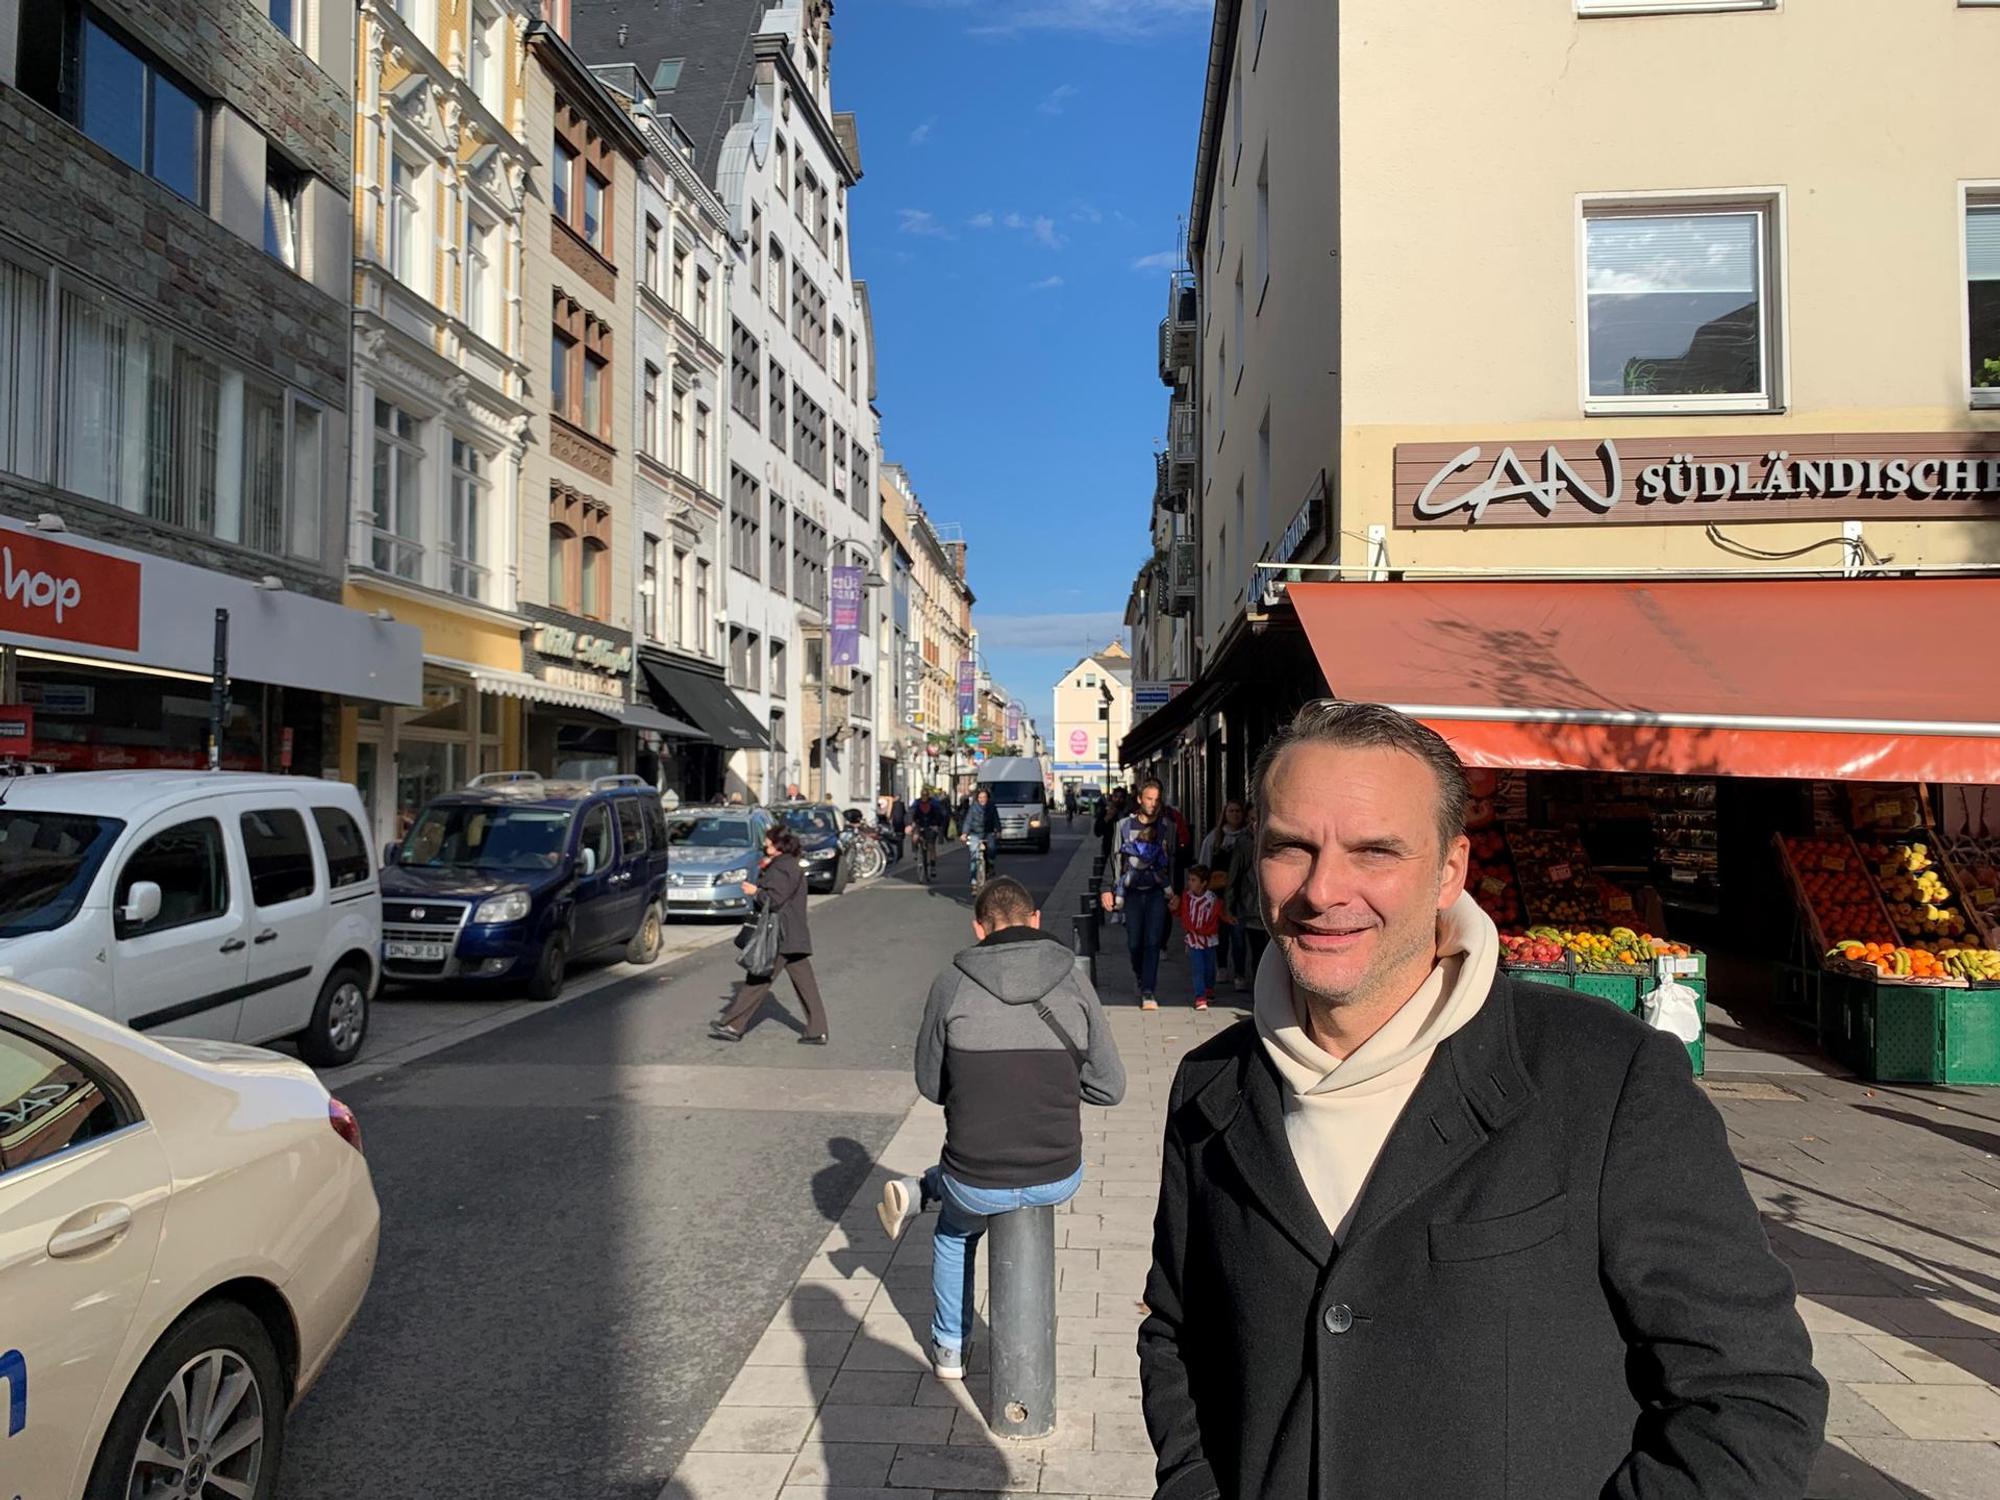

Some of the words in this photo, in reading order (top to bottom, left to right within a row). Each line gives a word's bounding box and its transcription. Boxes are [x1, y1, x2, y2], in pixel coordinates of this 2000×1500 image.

[1417, 439, 1621, 520] CAN
[0, 547, 81, 623] hop
[905, 643, 915, 723] MARANO
